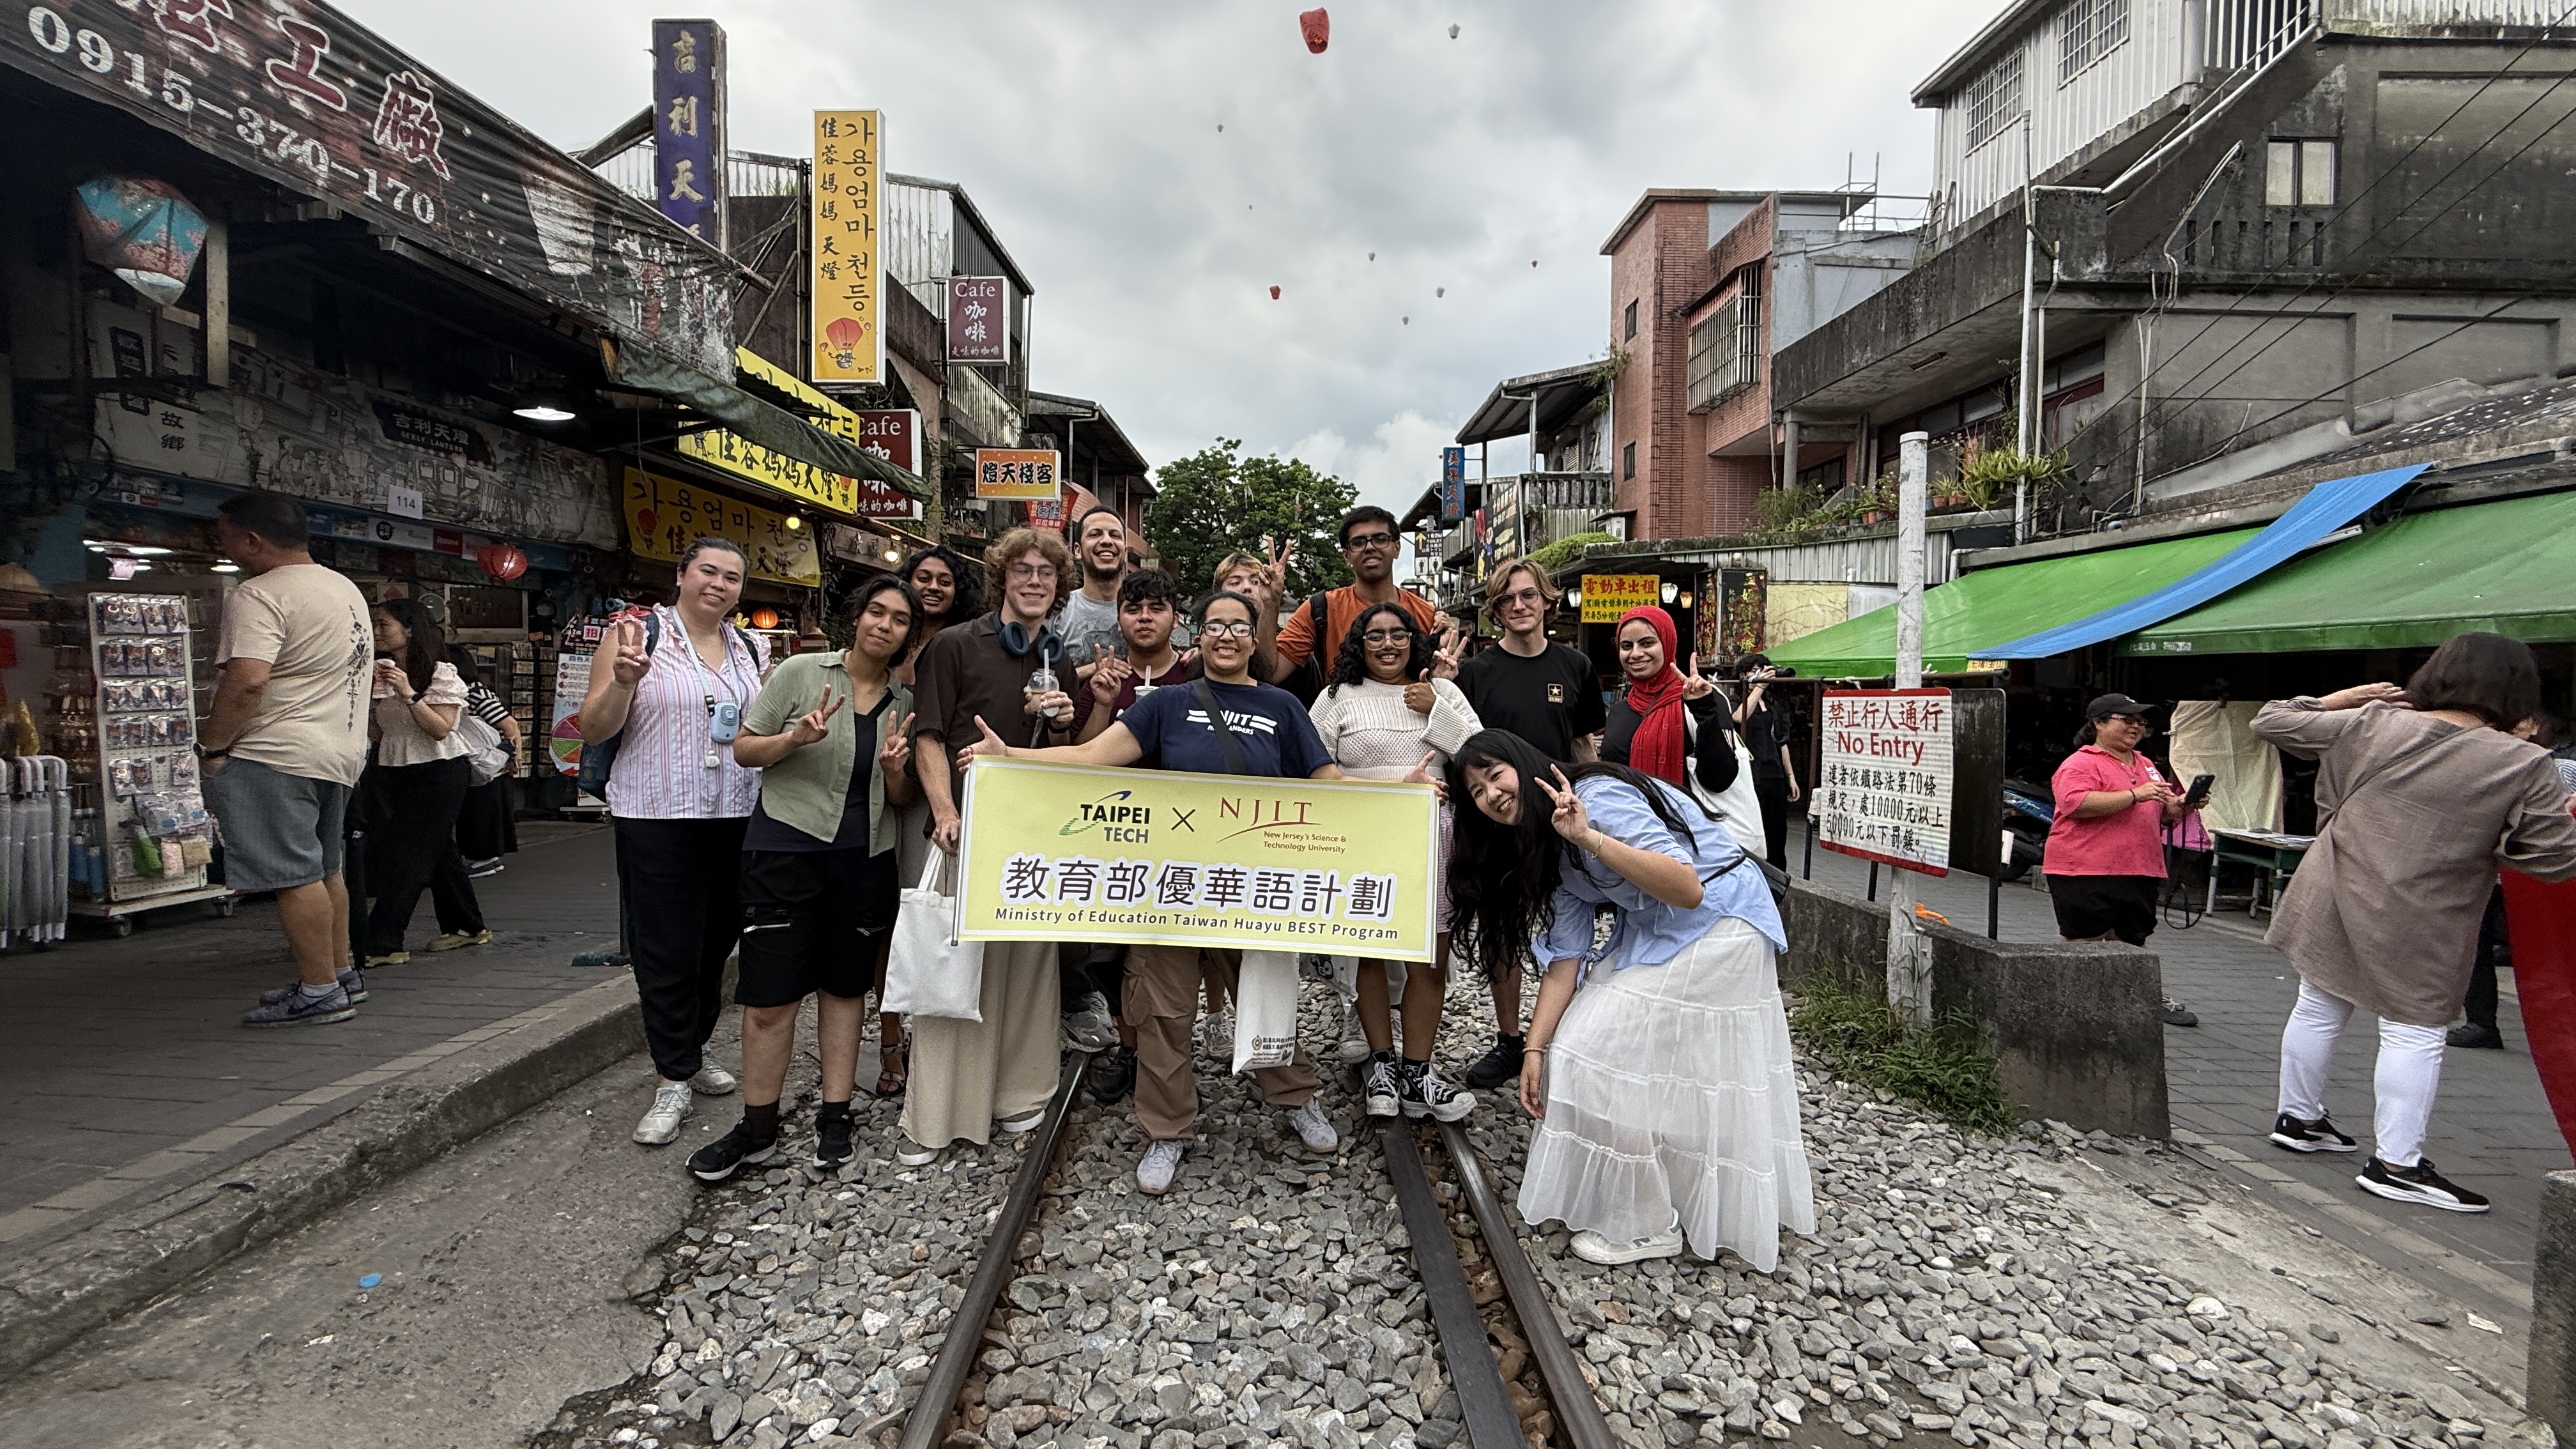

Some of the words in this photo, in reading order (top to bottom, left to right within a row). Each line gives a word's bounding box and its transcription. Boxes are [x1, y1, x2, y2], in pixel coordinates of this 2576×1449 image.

[27, 6, 434, 224] 0915-370-170
[669, 29, 705, 243] 吉利天
[842, 117, 875, 242] 가용엄마
[842, 251, 870, 312] 천등
[955, 282, 995, 297] Cafe
[964, 300, 987, 342] 咖啡
[392, 413, 469, 445] 吉利天燈
[401, 431, 425, 443] GEELY
[396, 495, 416, 510] 114
[630, 478, 755, 539] 가용엄마
[858, 498, 908, 512] 味的咖啡
[1584, 577, 1657, 595] 電動車出租
[1828, 700, 1943, 733] 禁止行人通行
[1837, 731, 1864, 753] No
[1871, 733, 1924, 766] Entry
[1080, 803, 1151, 824] TAIPEI
[1219, 797, 1312, 826] NJIT
[1104, 827, 1149, 843] TECH
[1264, 841, 1307, 852] Technology
[1308, 843, 1346, 854] University
[1282, 832, 1310, 841] Jersey's
[1006, 857, 1392, 917] 教育部優華語計劃
[995, 908, 1062, 924] Ministry
[1068, 909, 1084, 922] of
[1089, 910, 1167, 924] Education
[1174, 914, 1227, 928] Taiwan
[1234, 917, 1281, 933] Huayu
[1287, 921, 1326, 934] BEST
[1331, 924, 1398, 940] Program
